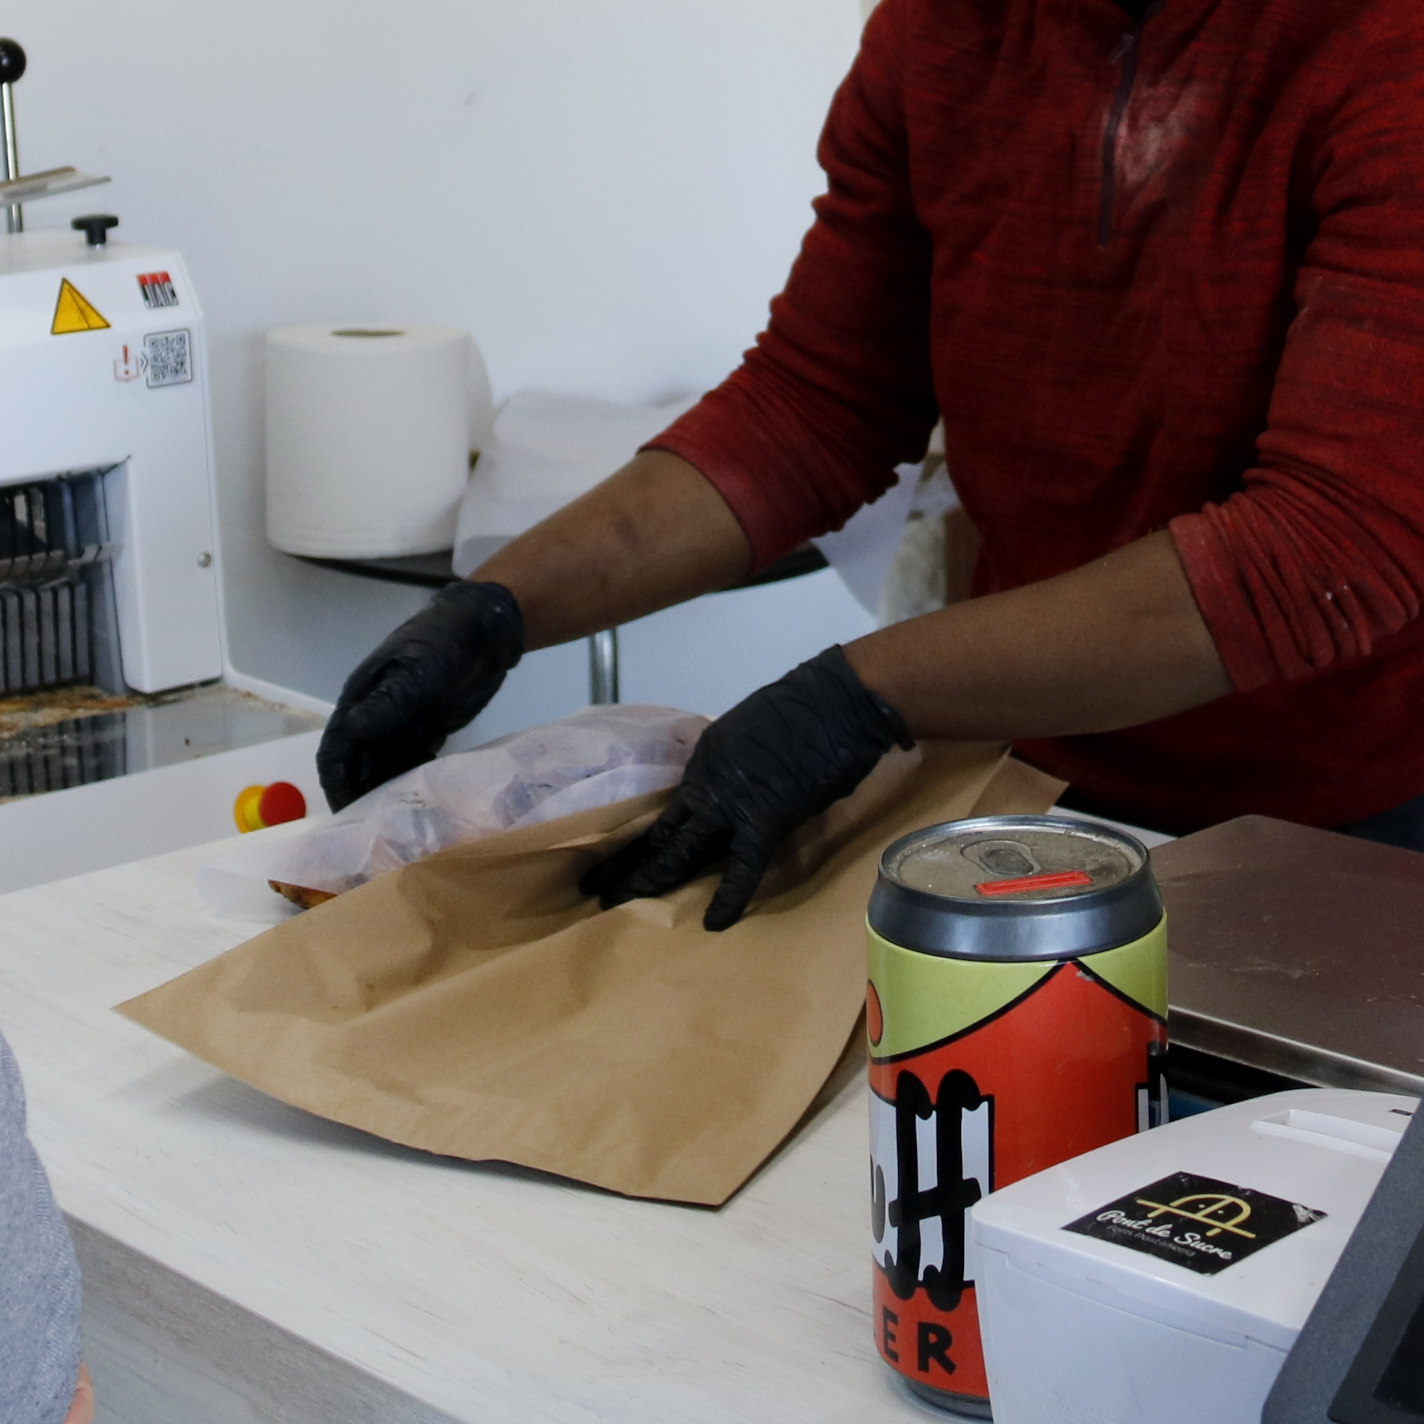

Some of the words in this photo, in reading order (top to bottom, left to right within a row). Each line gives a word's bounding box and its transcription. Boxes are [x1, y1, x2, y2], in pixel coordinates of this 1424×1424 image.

[1095, 1209, 1153, 1230] Pont
[1145, 1222, 1173, 1239] de
[1173, 1232, 1233, 1260] Sucre
[882, 1305, 957, 1375] ER
